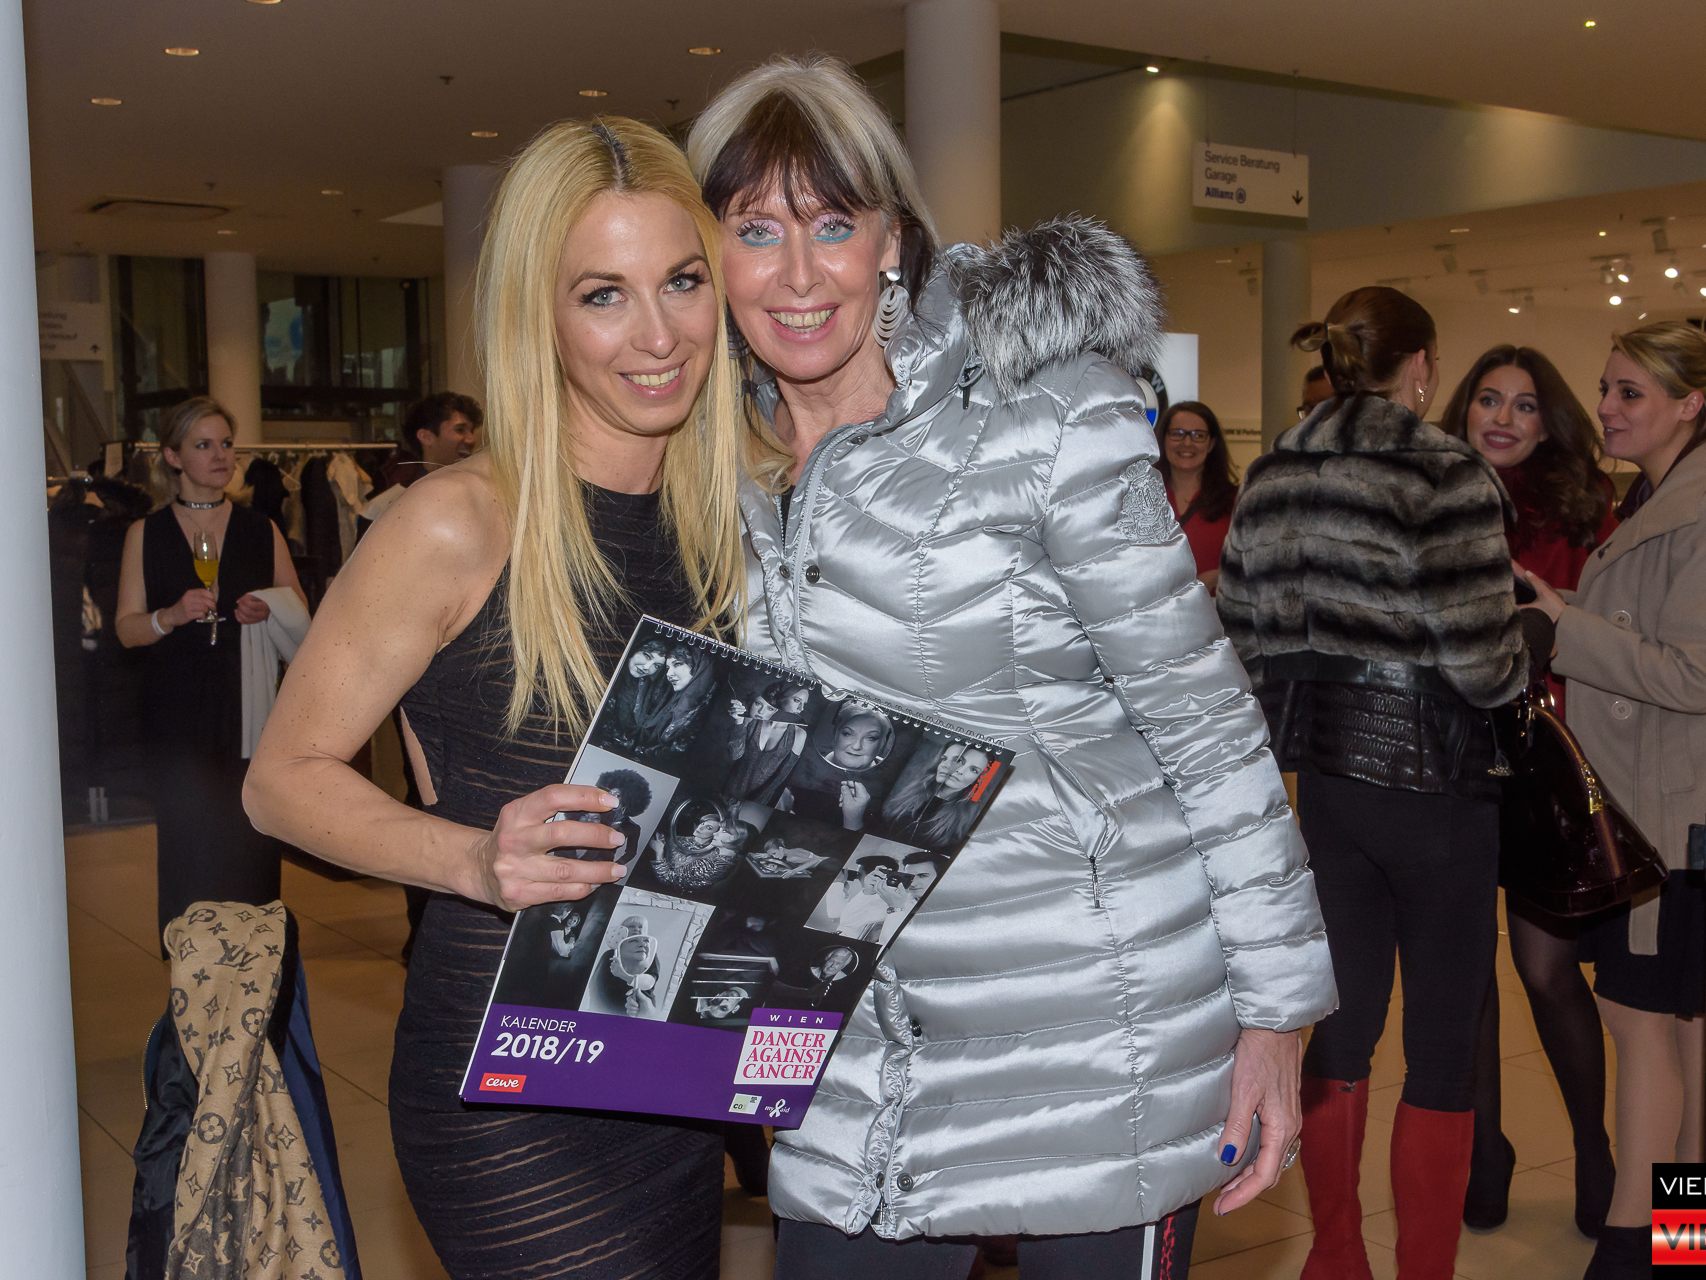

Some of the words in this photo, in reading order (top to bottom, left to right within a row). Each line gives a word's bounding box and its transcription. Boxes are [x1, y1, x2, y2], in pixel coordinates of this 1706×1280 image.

[1204, 150, 1239, 166] Service
[1240, 154, 1281, 174] Beratung
[1205, 167, 1238, 184] Garage
[1205, 186, 1234, 200] Allianz
[500, 1015, 577, 1033] KALENDER
[769, 1014, 824, 1024] WIEN
[750, 1030, 826, 1048] DANCER
[490, 1032, 605, 1065] 2018/19
[746, 1047, 827, 1064] AGAINST
[742, 1063, 816, 1079] CANCER
[485, 1077, 519, 1088] cewe
